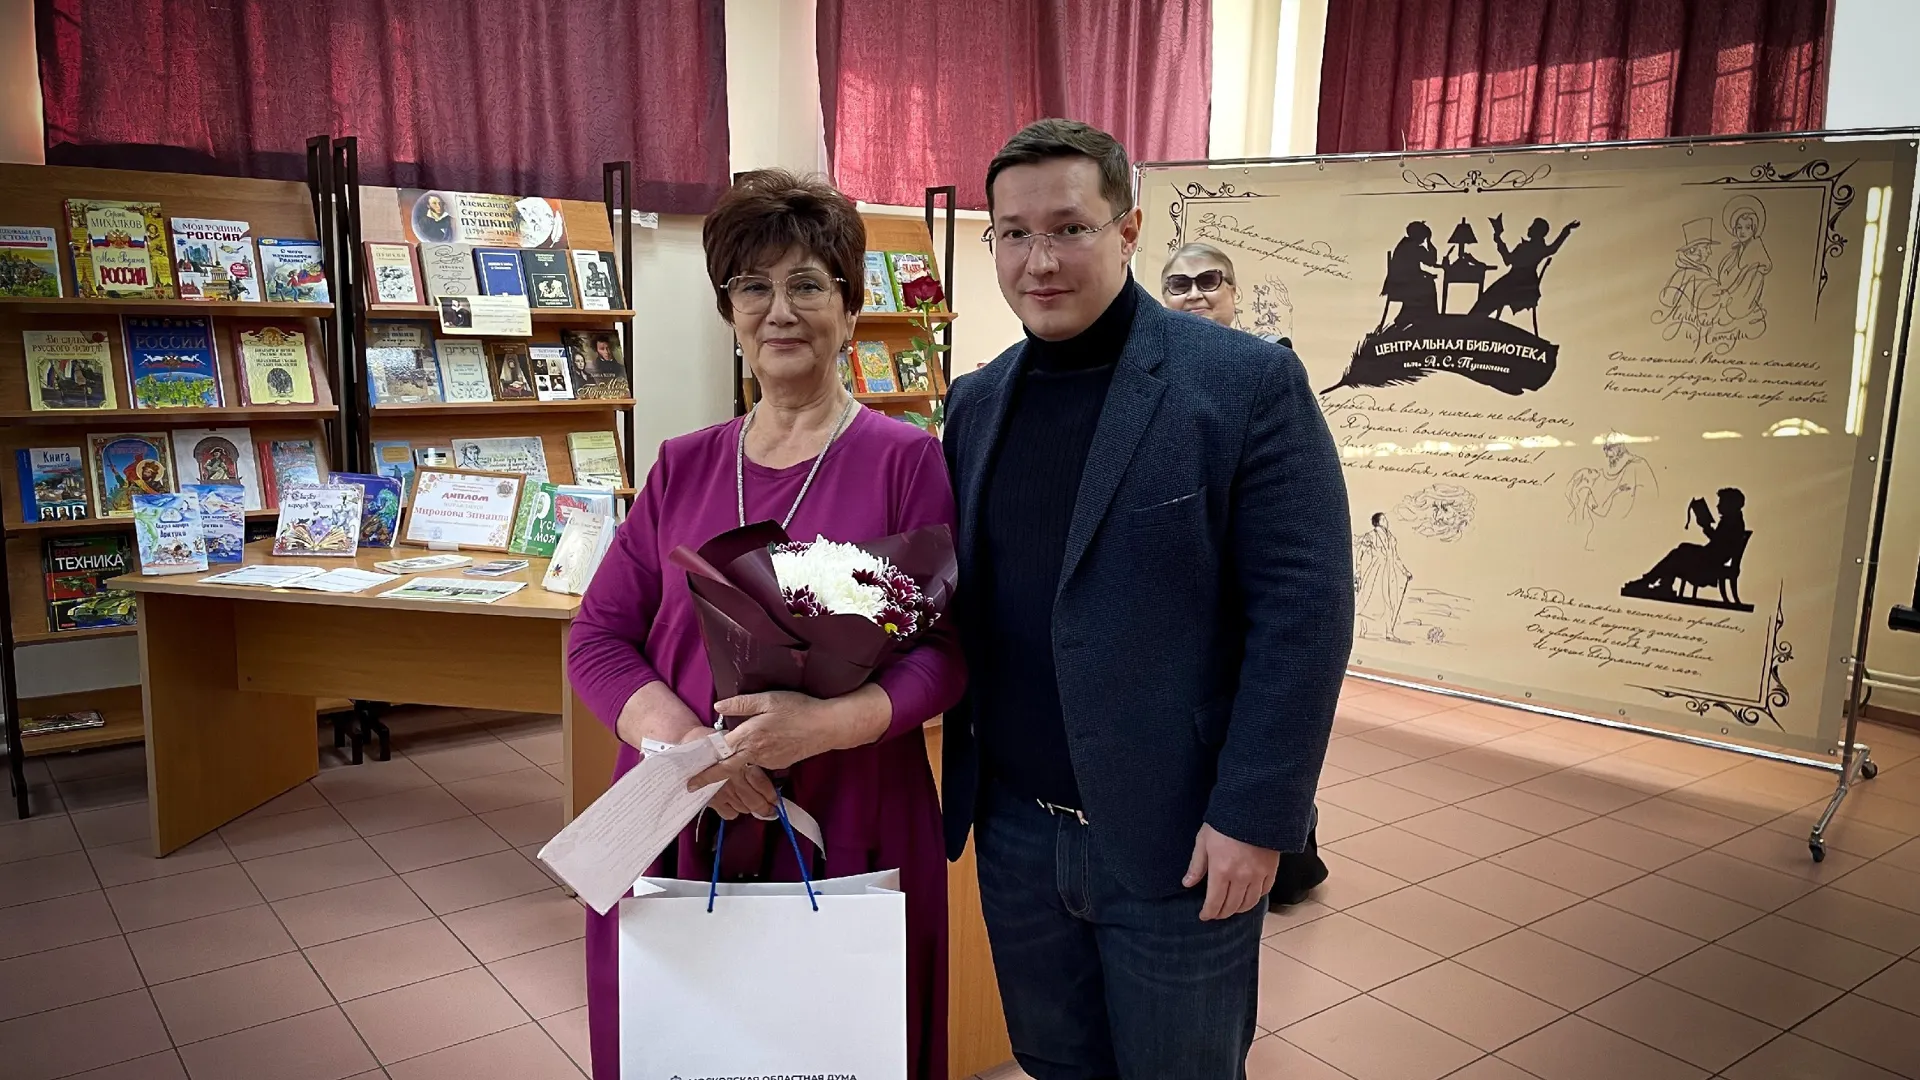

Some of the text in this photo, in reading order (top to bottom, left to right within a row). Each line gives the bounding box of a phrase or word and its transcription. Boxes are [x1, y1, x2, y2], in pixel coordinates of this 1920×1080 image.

[459, 199, 510, 211] Александр
[461, 208, 513, 218] Сергеевич
[91, 218, 143, 229] МИХАЛКОВ
[182, 222, 243, 233] МОЯ РОДИНА
[461, 217, 517, 230] ПУШКИН
[0, 234, 53, 242] СТОМАТИЯ
[187, 231, 241, 242] РОССИЯ
[1246, 246, 1300, 265] старины
[1260, 238, 1321, 257] минувших
[96, 251, 145, 267] Моя Родина
[100, 265, 148, 286] РОССИЯ
[135, 335, 207, 350] РОССИИ
[1375, 339, 1548, 364] ЦЕНТРАЛЬНАЯ БИБЛИОТЕКА
[1424, 355, 1440, 368] А.
[1442, 355, 1455, 368] С.
[1457, 356, 1511, 374] Пушкина
[1608, 351, 1638, 361] Они
[1700, 351, 1747, 365] Волна
[1763, 360, 1821, 371] камень,
[1667, 371, 1717, 387] проза,
[1761, 379, 1828, 388] пламень
[1604, 380, 1620, 391] Не
[1622, 386, 1664, 394] столь
[1662, 386, 1743, 401] различны
[1788, 390, 1828, 404] собой
[1317, 395, 1364, 416] Чужой
[1400, 400, 1435, 418] всех,
[1439, 409, 1484, 419] ничем
[1486, 412, 1504, 421] не
[1507, 408, 1575, 429] связан,
[1339, 415, 1361, 429] Я
[1412, 421, 1487, 440] вольность
[43, 451, 71, 463] Книга
[1498, 450, 1546, 465] мой!
[1360, 460, 1376, 470] я
[1378, 462, 1438, 478] ошибся,
[1442, 470, 1471, 479] как
[1473, 472, 1556, 489] наказан!
[441, 492, 489, 502] ДИПЛОМ
[413, 506, 510, 521] Миронова Зинаида
[55, 553, 125, 571] ТЕХНИКА
[1506, 588, 1539, 600] Мой
[1578, 604, 1623, 614] самых
[1626, 609, 1684, 622] честных
[1686, 616, 1746, 634] правил,
[1534, 605, 1709, 645] Когда не в шутку занемог,
[1526, 623, 1545, 634] Он
[1537, 626, 1610, 645] уважать
[1642, 647, 1715, 662] заставил
[1548, 646, 1585, 659] лучше
[1587, 645, 1653, 668] выдумать
[1654, 663, 1670, 671] не
[1672, 667, 1703, 677] мог.
